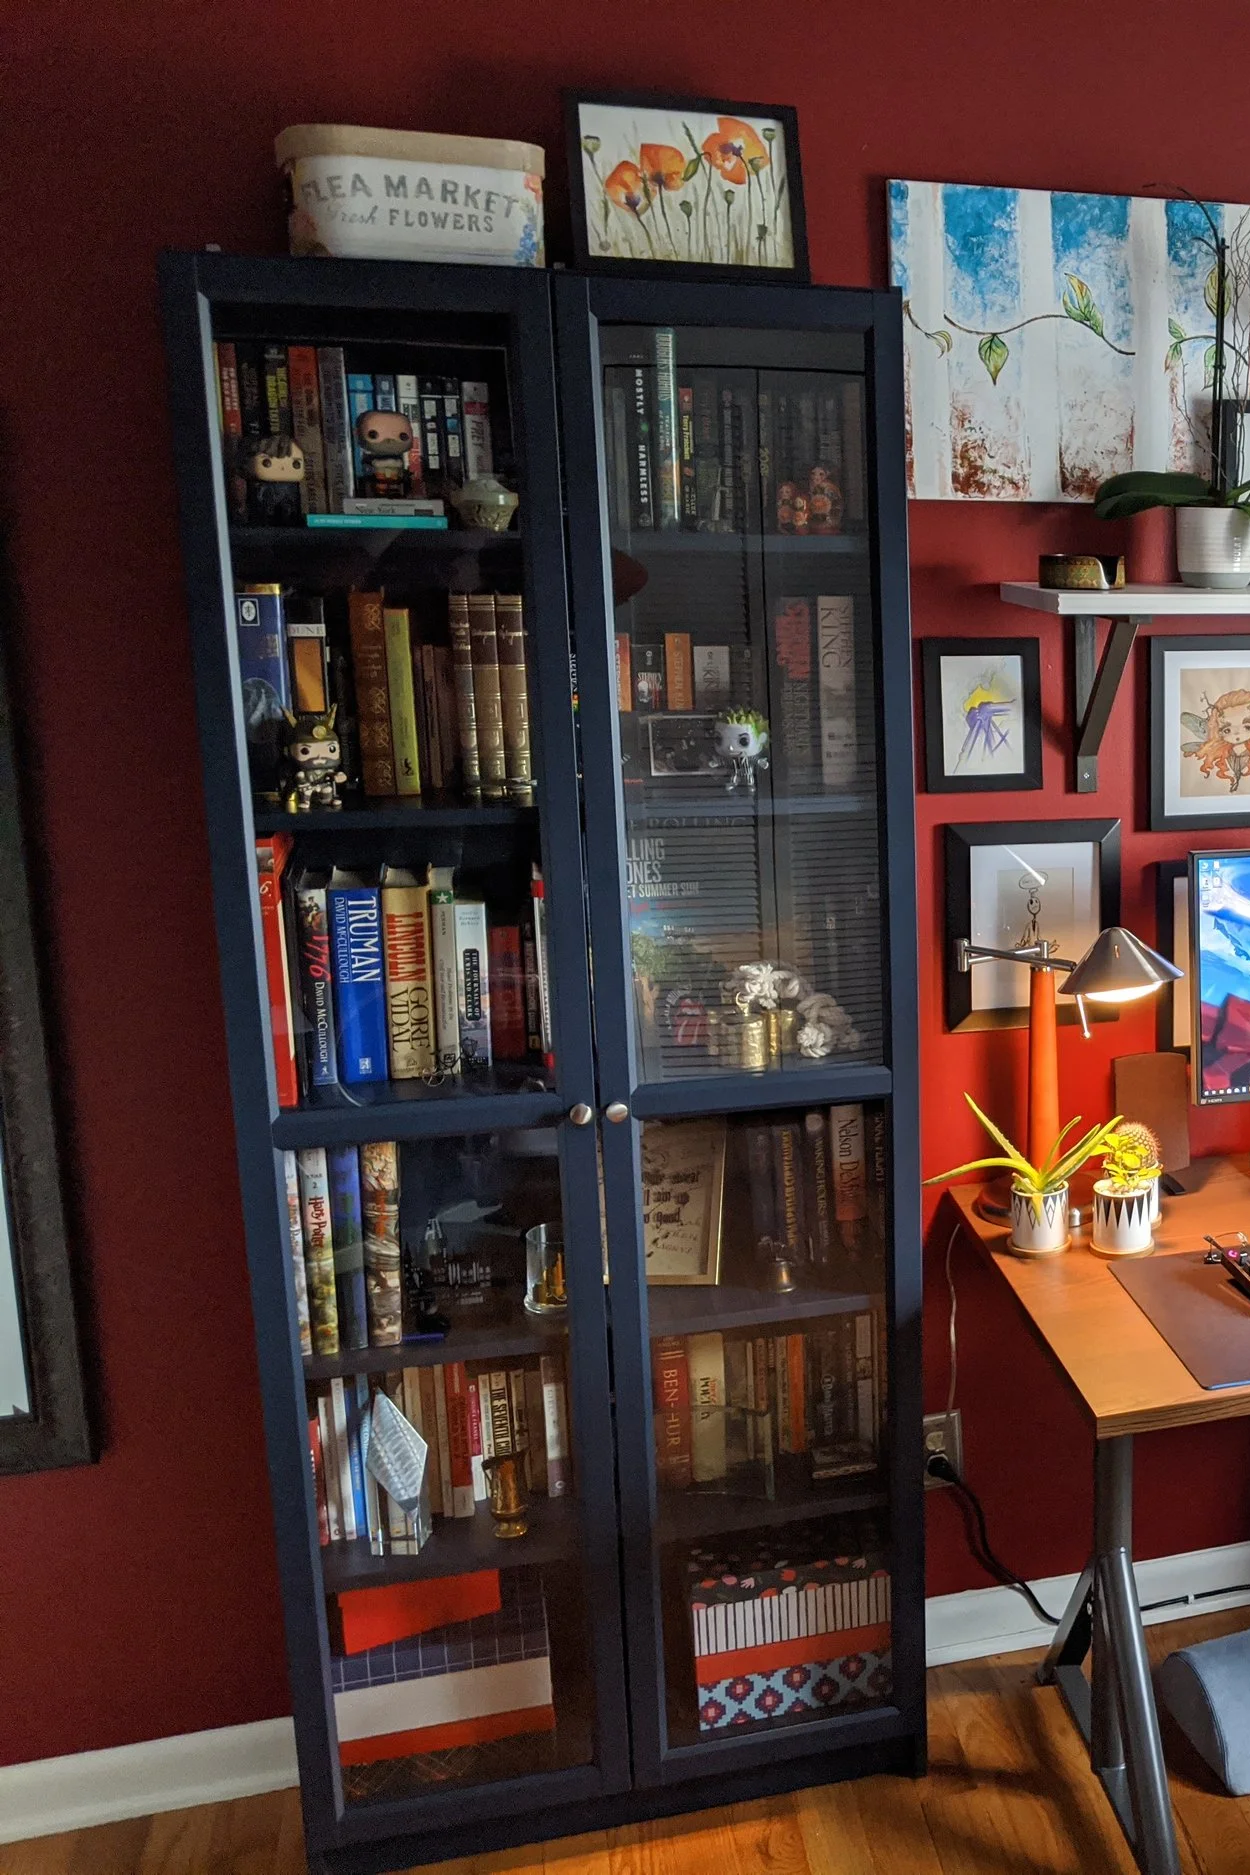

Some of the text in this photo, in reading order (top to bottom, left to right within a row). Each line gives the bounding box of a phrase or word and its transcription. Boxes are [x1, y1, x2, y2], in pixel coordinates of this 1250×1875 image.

[301, 173, 518, 218] FLEA MARKET
[388, 208, 494, 232] FLOWERS
[471, 420, 486, 449] PREY
[635, 368, 649, 504] MOSTLY HARMLESS
[682, 414, 690, 429] Terry
[288, 626, 325, 636] DUNE
[820, 606, 842, 668] KING
[839, 604, 852, 668] STEPHEN
[673, 651, 685, 690] STEPHEN
[334, 896, 347, 924] DAVID
[638, 882, 680, 898] SUMMER
[304, 934, 332, 982] 1776
[347, 895, 382, 983] TRUMAN
[386, 911, 426, 982] LINCOLN
[390, 987, 411, 1053] VIDAL
[408, 986, 430, 1051] GORE
[815, 1135, 826, 1179] WAKING
[837, 1117, 860, 1157] Nelson
[312, 1181, 319, 1189] 2
[816, 1180, 827, 1217] HOURS
[308, 1196, 327, 1248] Harry Potter
[491, 1387, 507, 1403] THE
[663, 1368, 681, 1448] BEN-HUR
[492, 1403, 510, 1440] SEVENTH
